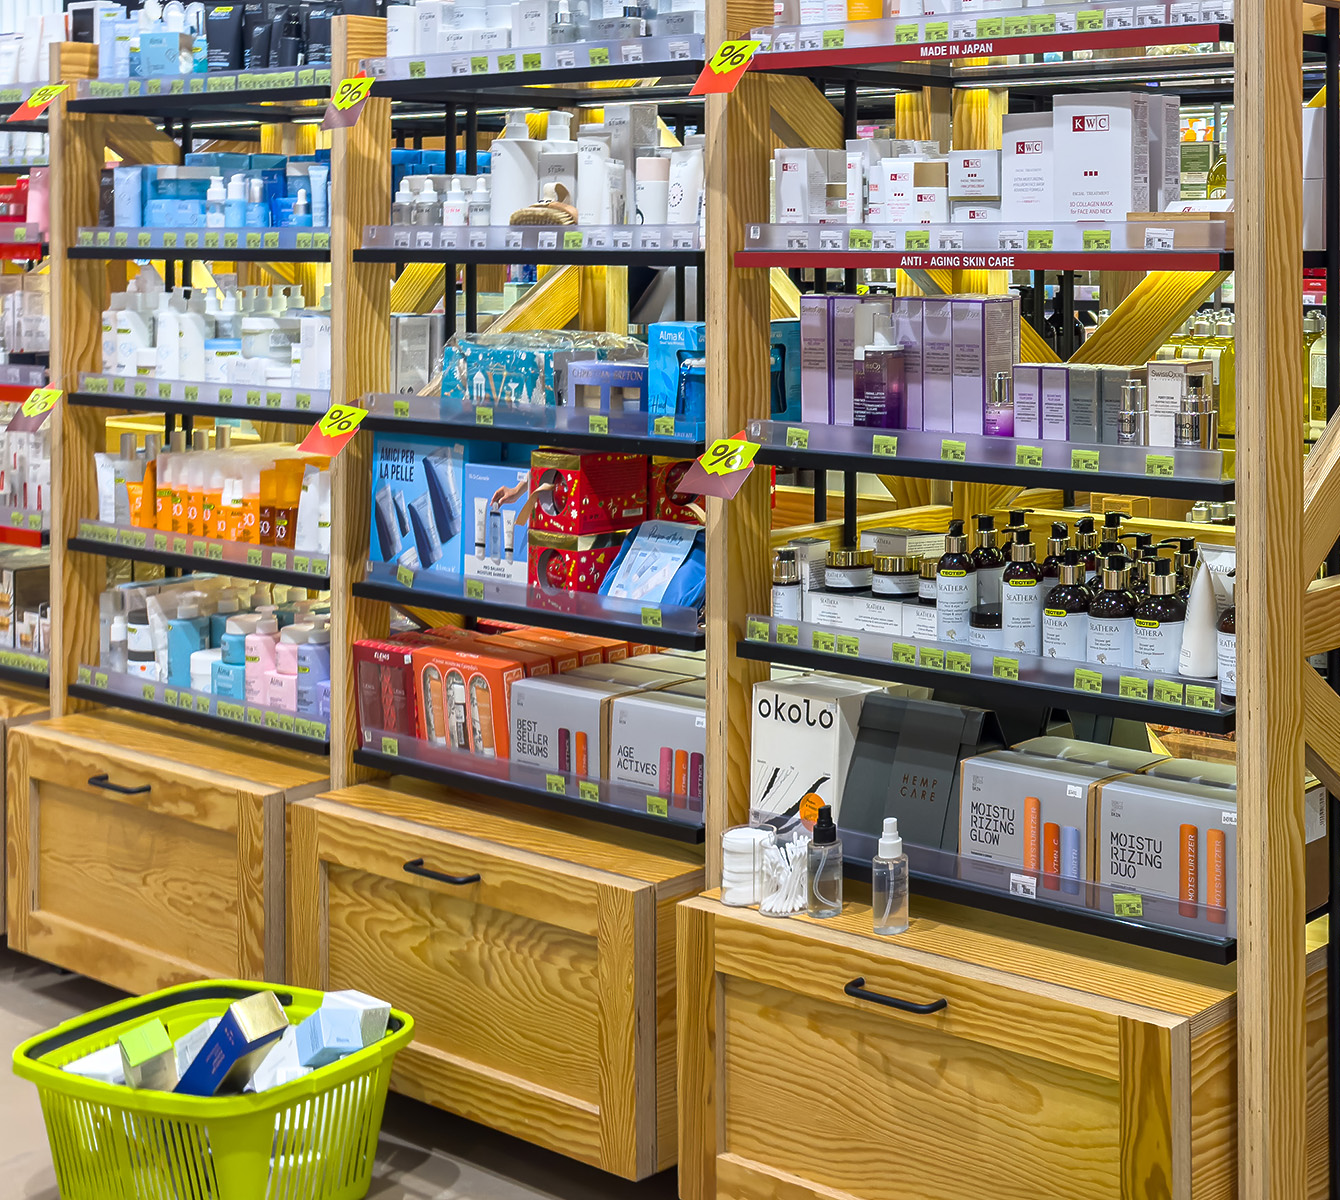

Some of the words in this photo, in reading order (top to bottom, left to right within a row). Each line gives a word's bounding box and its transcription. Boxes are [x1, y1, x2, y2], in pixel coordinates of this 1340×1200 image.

[920, 46, 947, 57] MADE
[950, 45, 959, 55] IN
[961, 43, 993, 55] JAPAN
[1073, 115, 1109, 132] KWC
[1016, 141, 1042, 154] KWC
[963, 159, 981, 168] KWC
[901, 256, 922, 266] ANTI
[930, 256, 960, 267] AGING
[963, 256, 985, 266] SKIN
[988, 256, 1014, 267] CARE
[659, 331, 677, 340] Alma
[380, 448, 400, 462] AMICI
[401, 449, 414, 464] PER
[380, 465, 389, 479] LA
[391, 465, 414, 482] PELLE
[1006, 593, 1038, 601] SEATHERA
[1090, 623, 1119, 633] SEATHERA
[758, 694, 833, 729] okolo
[517, 718, 538, 732] BEST
[517, 730, 548, 746] SELLER
[517, 742, 548, 758] SERUMS
[617, 745, 634, 758] AGE
[617, 758, 657, 776] ACTIVES
[903, 774, 937, 787] HEMP
[900, 786, 935, 802] CARE
[971, 802, 1015, 821] MOISTU
[971, 815, 1015, 835] RIZING
[970, 829, 1000, 846] GLOW
[1110, 832, 1162, 854] MOISTU
[1111, 846, 1162, 869] RIZING
[1110, 862, 1136, 878] DUO
